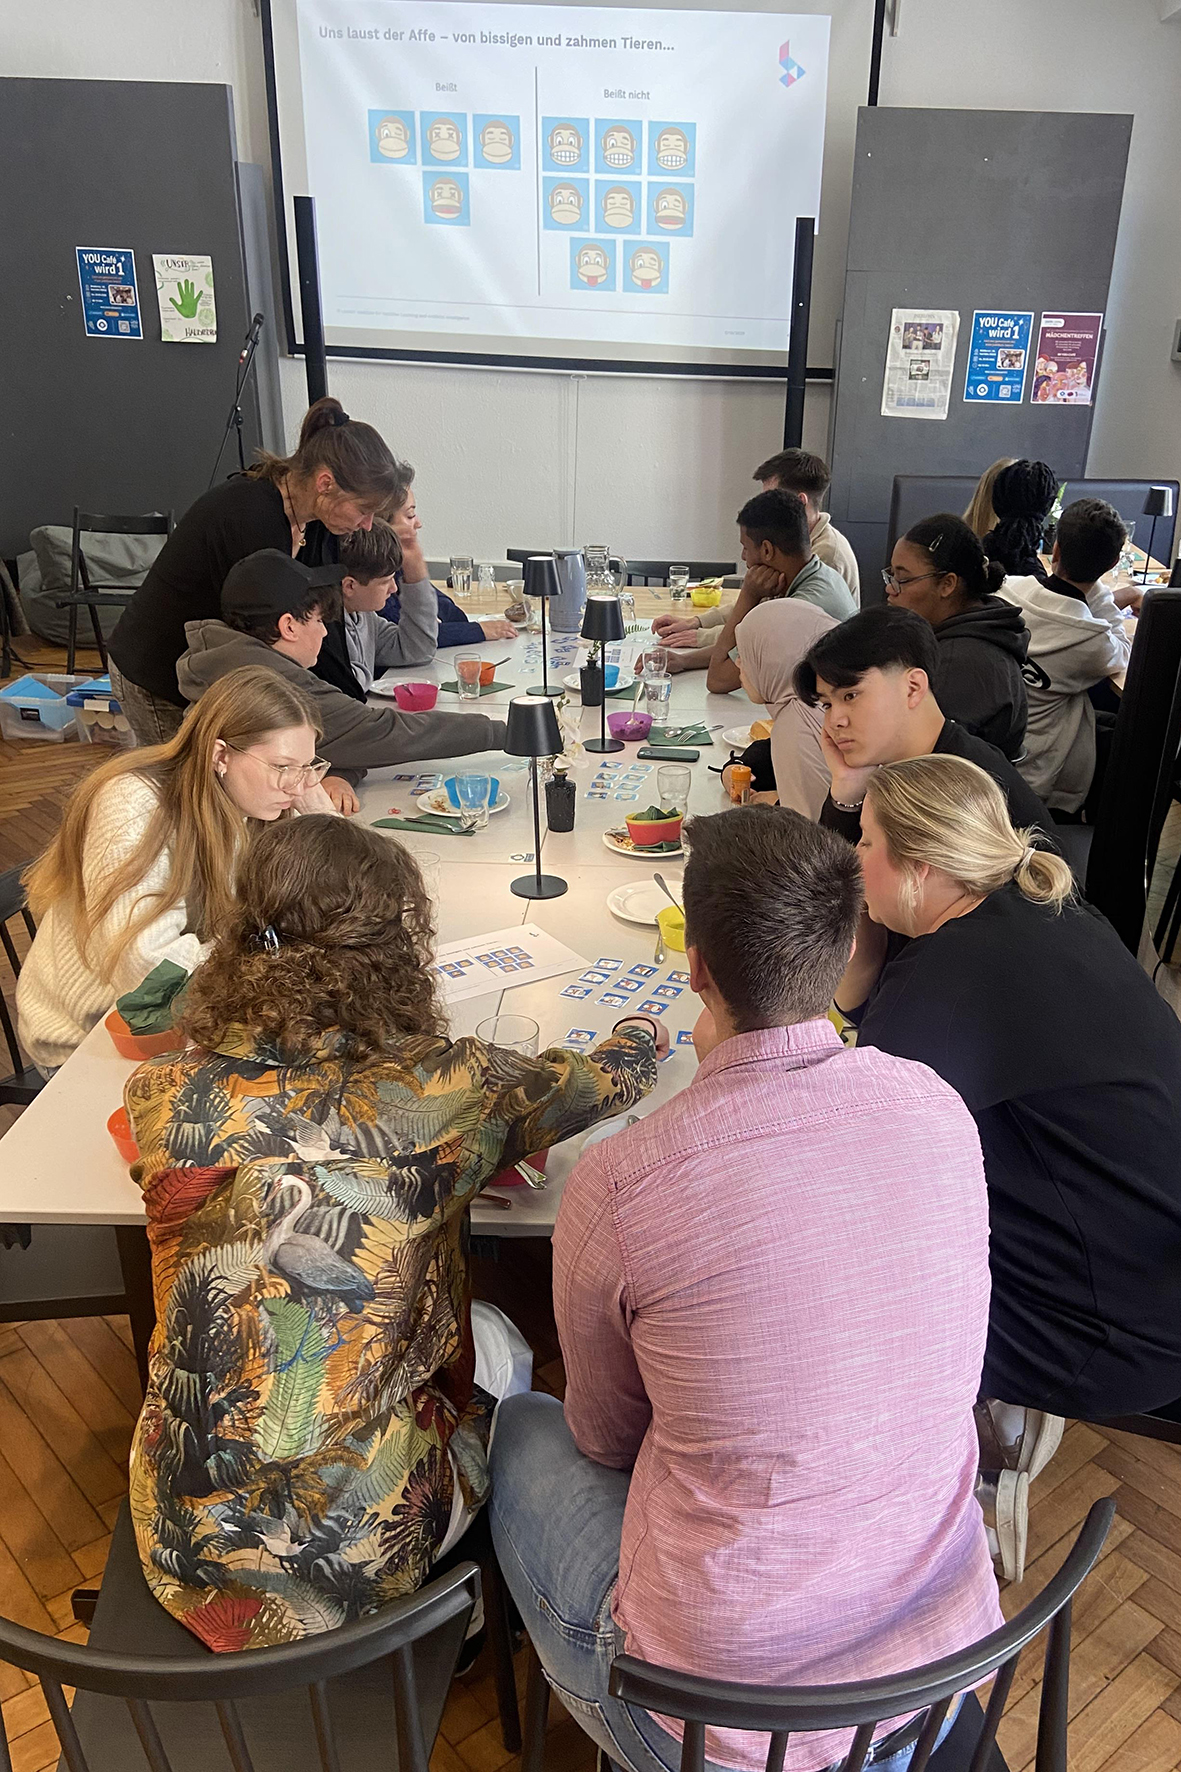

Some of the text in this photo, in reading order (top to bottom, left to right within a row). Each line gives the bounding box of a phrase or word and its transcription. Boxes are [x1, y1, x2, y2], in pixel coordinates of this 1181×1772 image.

[318, 25, 343, 39] Uns
[347, 26, 380, 40] laust
[383, 27, 405, 41] der
[408, 28, 436, 42] Affe
[452, 32, 476, 43] von
[480, 31, 533, 48] bissigen
[536, 33, 562, 46] und
[565, 35, 617, 48] zahmen
[621, 36, 675, 50] Tieren...
[435, 82, 458, 92] Beißt
[603, 88, 650, 100] Beißt nicht
[82, 253, 117, 264] YOU Café
[94, 262, 125, 276] wird 1
[979, 316, 1015, 328] YOU Café
[988, 325, 1020, 339] wird 1
